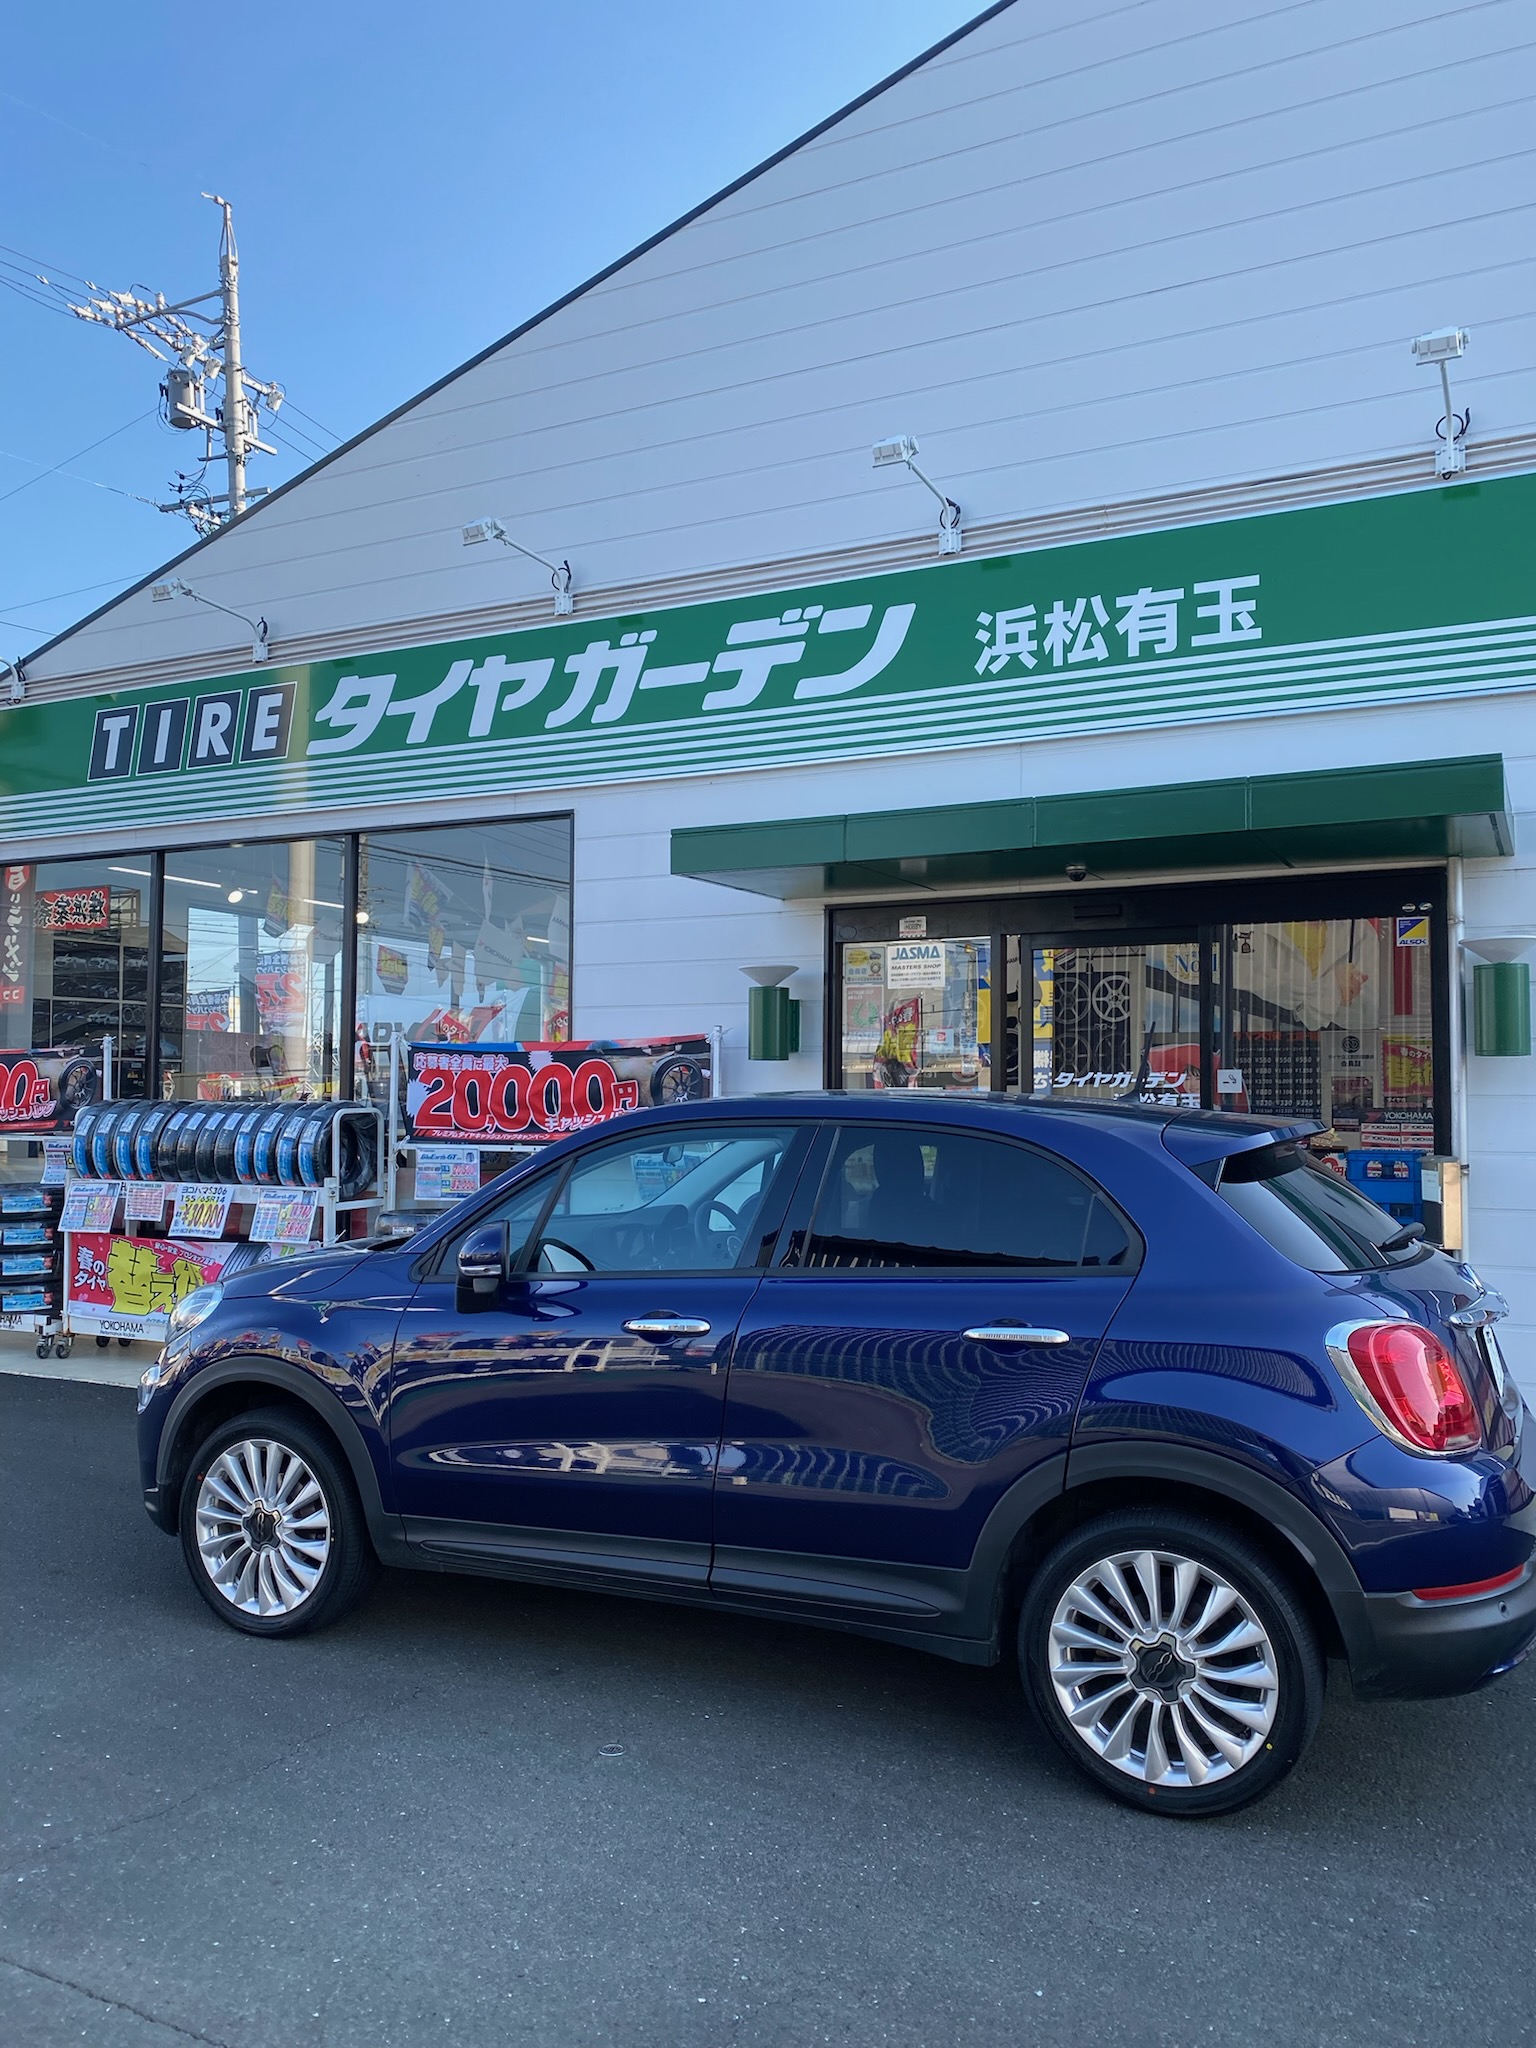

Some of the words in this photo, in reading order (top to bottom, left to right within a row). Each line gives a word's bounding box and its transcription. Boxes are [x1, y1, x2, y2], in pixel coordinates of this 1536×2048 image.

[973, 574, 1263, 675] 浜松有玉
[306, 603, 917, 756] タイヤガーデン
[98, 693, 289, 772] TIRE
[891, 945, 941, 960] JASMA
[413, 1058, 639, 1132] 20,000円
[1384, 1112, 1434, 1120] YOKOHAMA
[76, 1246, 106, 1276] 春の
[74, 1270, 107, 1292] タイヤ
[100, 1320, 144, 1334] YOKOHAMA
